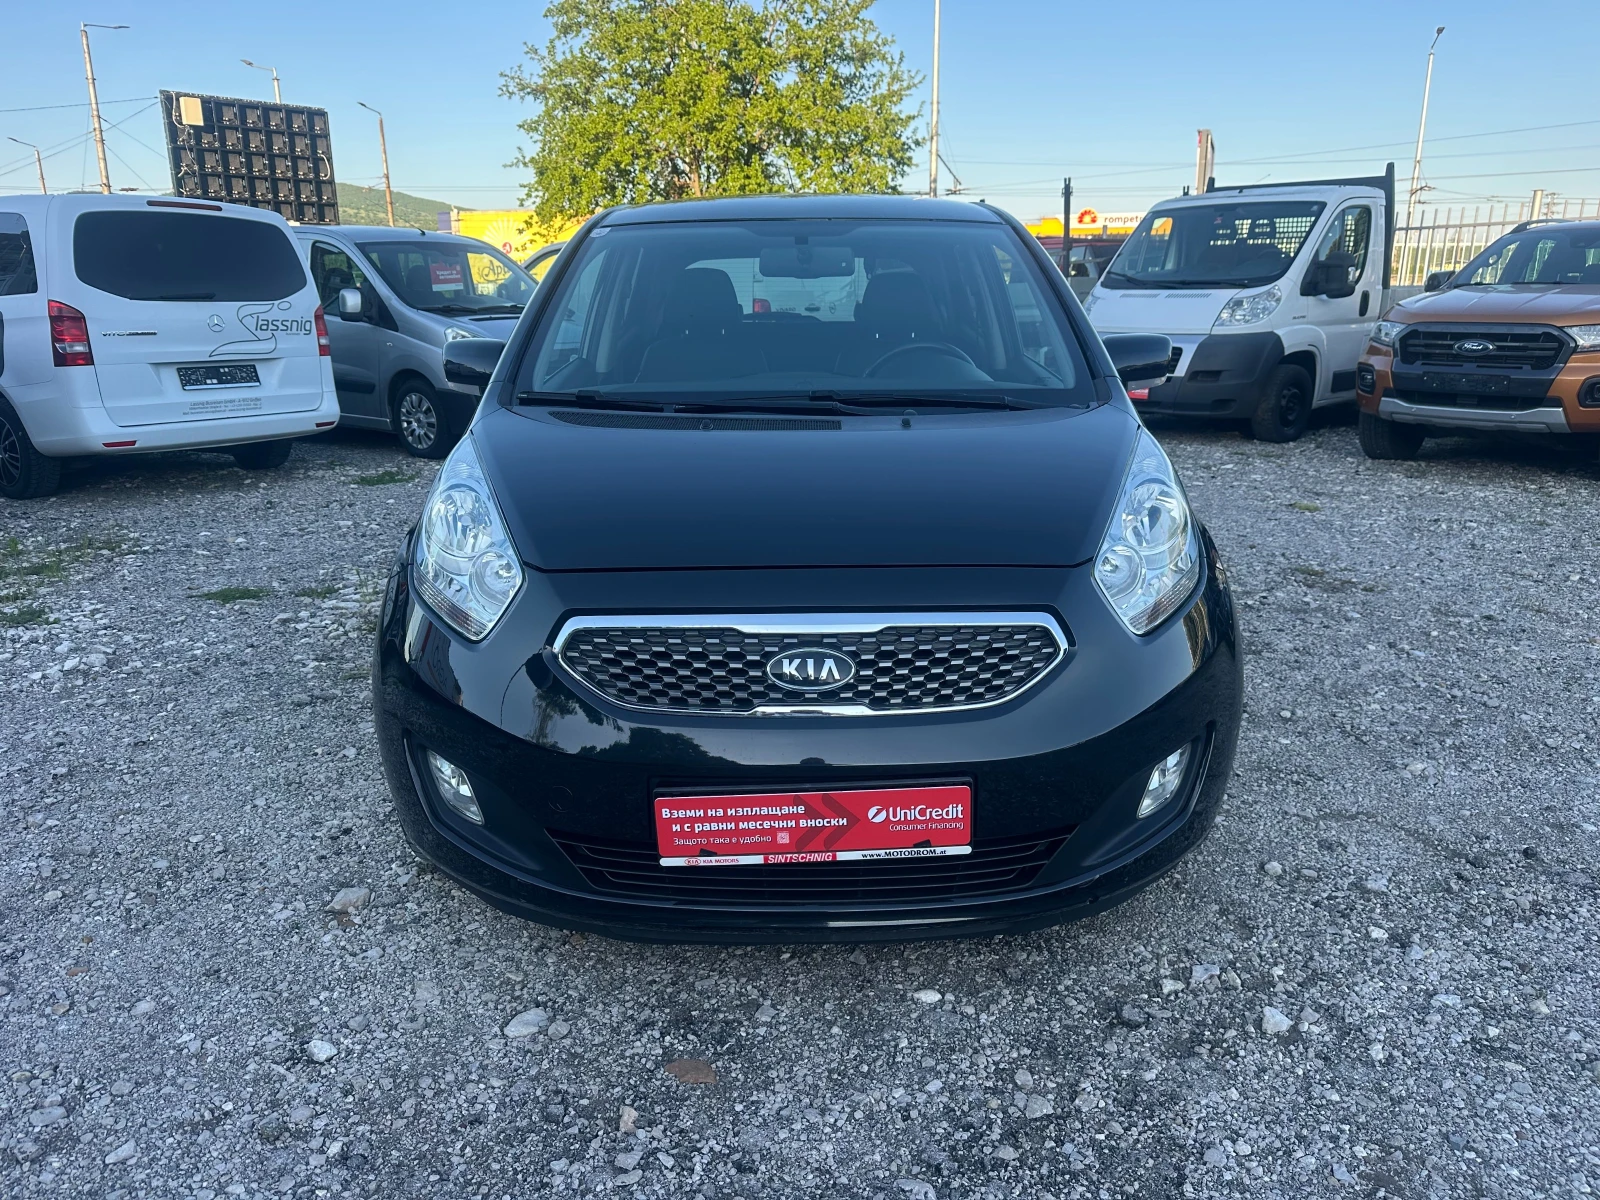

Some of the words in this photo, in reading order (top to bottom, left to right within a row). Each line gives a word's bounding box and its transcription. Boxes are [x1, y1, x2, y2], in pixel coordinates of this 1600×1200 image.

[781, 658, 841, 680] KIA
[661, 808, 704, 818] Вземи
[707, 808, 724, 817] на
[727, 805, 805, 816] изплащане
[889, 803, 964, 821] UniCredit
[672, 823, 681, 832] и
[683, 823, 692, 831] с
[694, 822, 736, 833] равни
[738, 820, 796, 829] месечни
[799, 818, 847, 827] вноски
[889, 823, 927, 831] Consumer
[928, 821, 964, 830] Financing
[673, 837, 707, 846] Защото
[739, 835, 772, 845] удобно
[767, 852, 833, 863] SINTSCHNIG
[861, 849, 947, 859] www.MOTODROM.at
